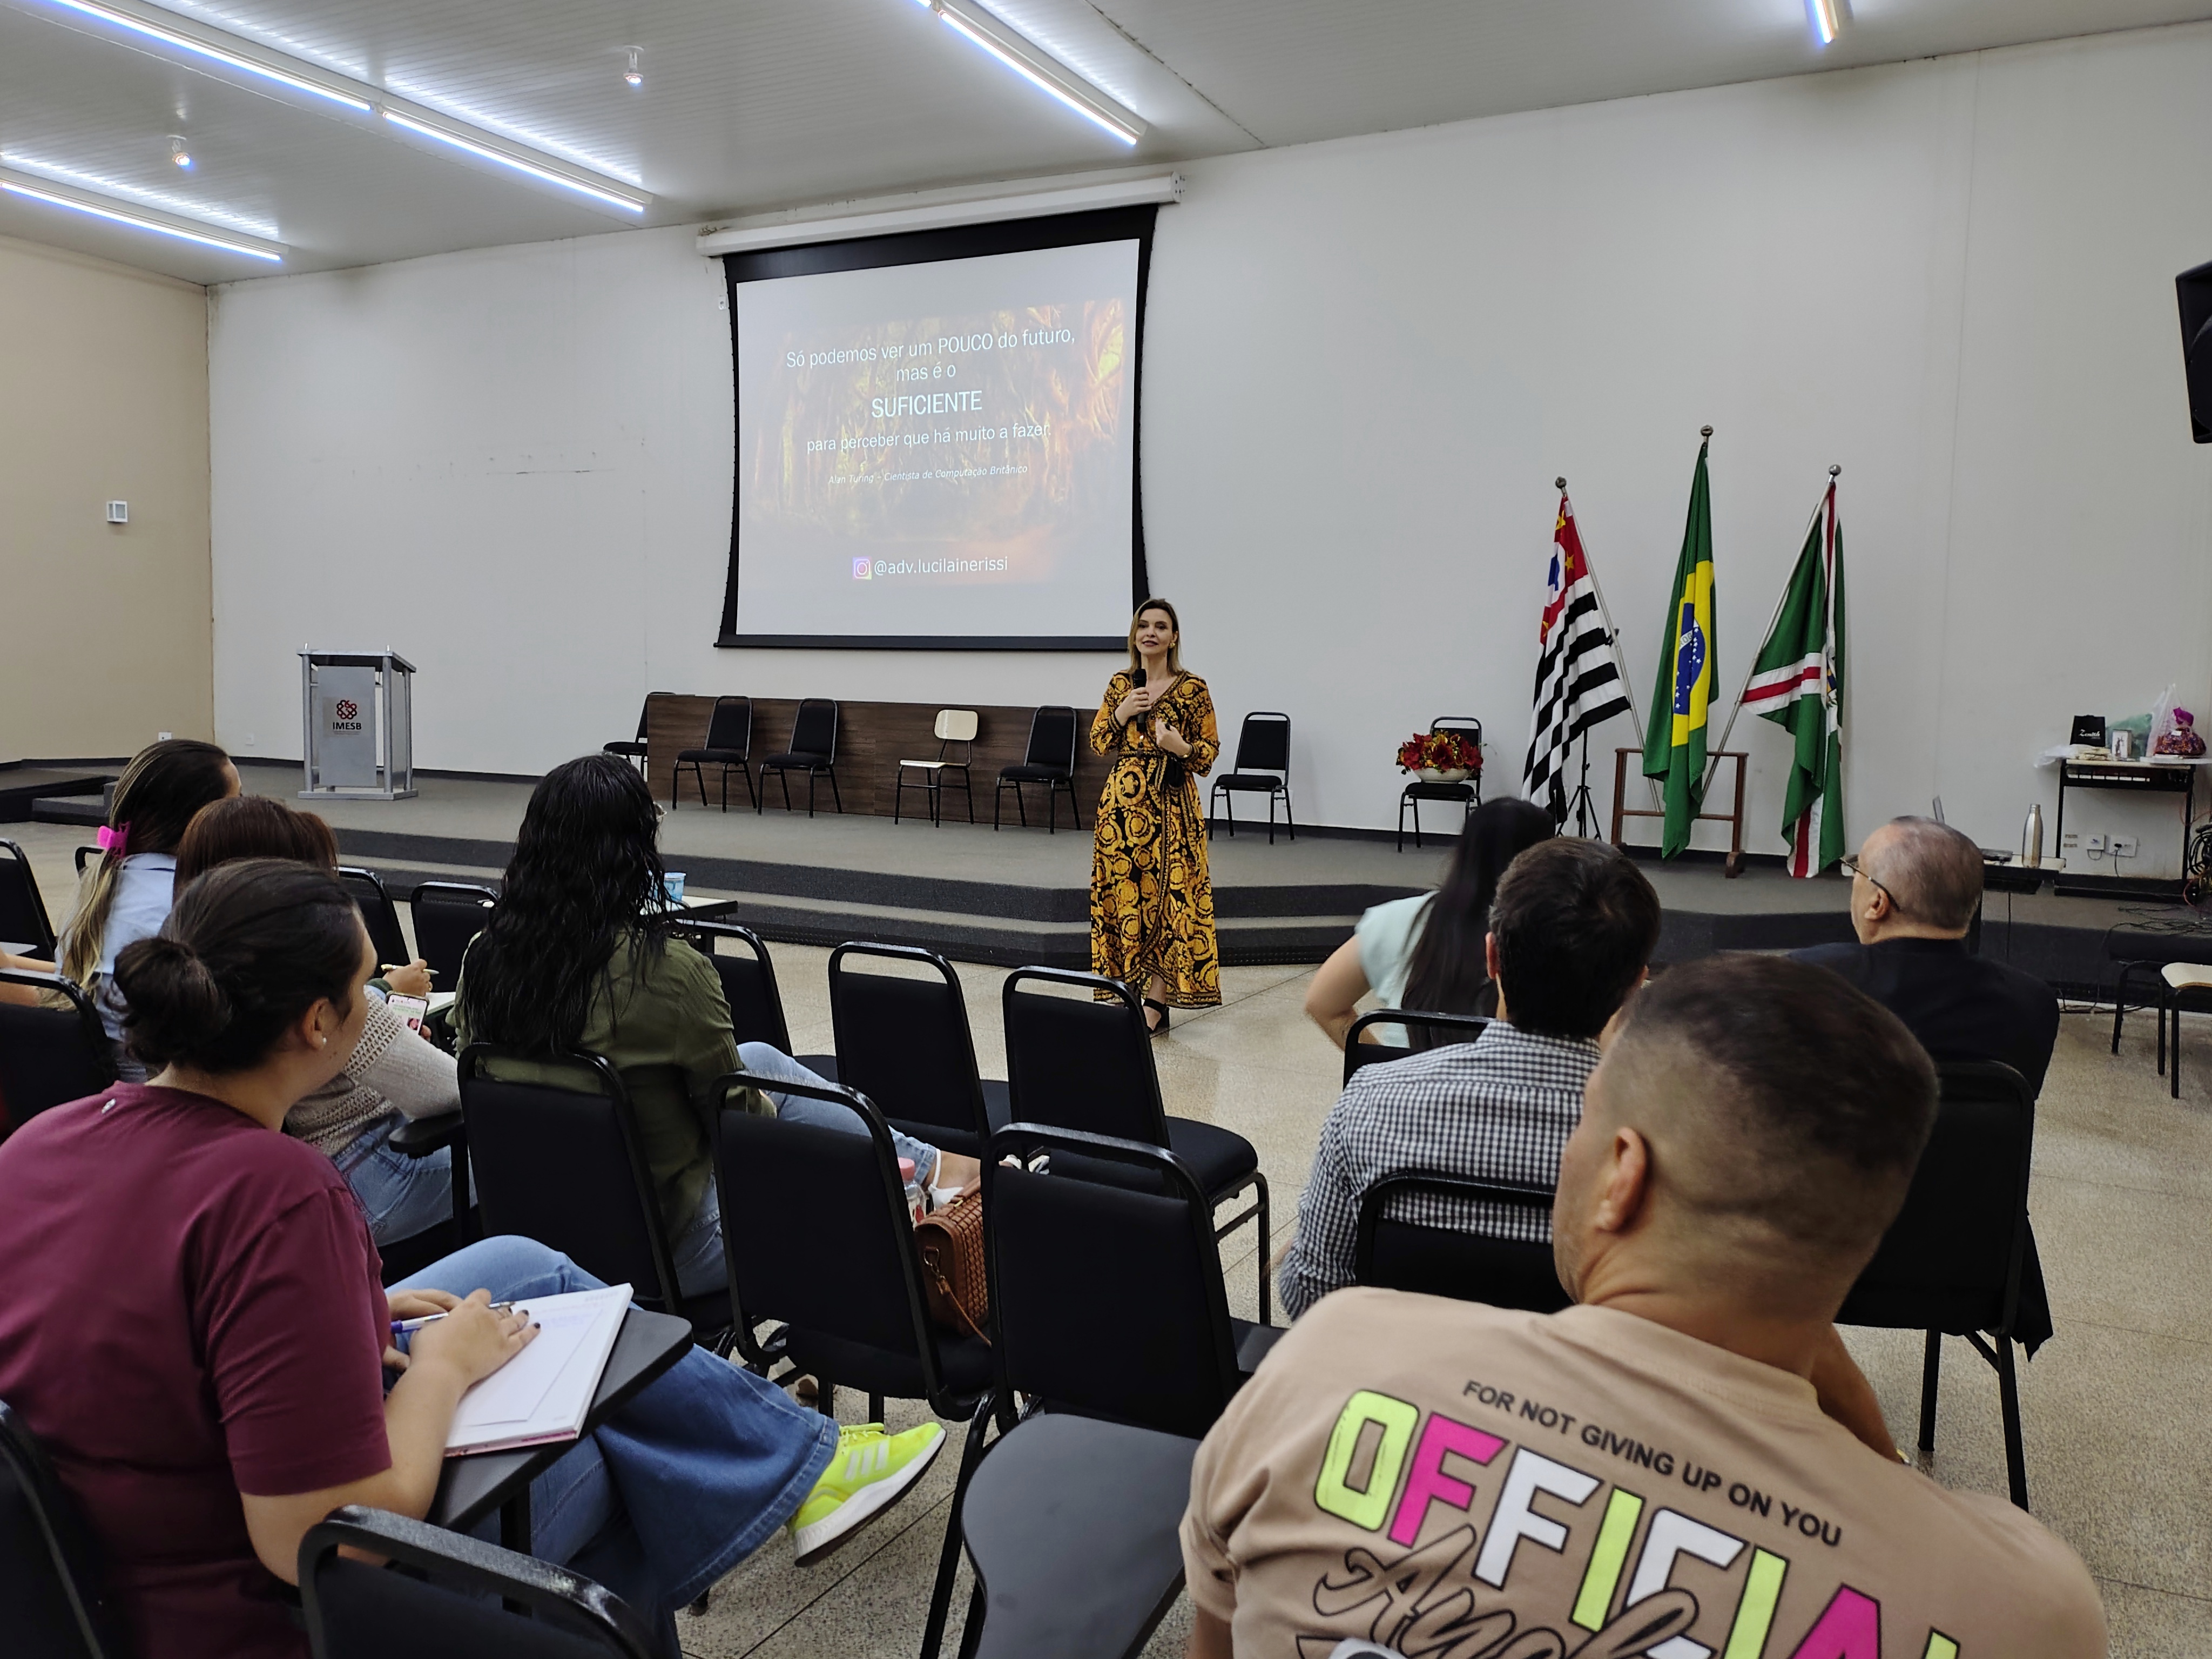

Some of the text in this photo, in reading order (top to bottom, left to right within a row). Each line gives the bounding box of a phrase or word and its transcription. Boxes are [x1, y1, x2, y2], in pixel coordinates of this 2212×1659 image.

[786, 328, 1075, 369] Só podemos ver um POUCO do futuro,
[896, 361, 956, 381] mas é o
[871, 390, 982, 418] SUFICIENTE
[807, 422, 1051, 455] para perceber que há muito a fazer.
[828, 475, 846, 484] Alan
[849, 475, 874, 484] Turing
[884, 471, 920, 481] Cientista
[922, 470, 933, 478] de
[935, 467, 988, 478] Computação
[989, 464, 1028, 475] Britânico
[874, 556, 1008, 576] @adv.lucilainerissi
[332, 721, 362, 730] IMESB
[1463, 1379, 1842, 1547] FOR NOT GIVING UP ON YOU
